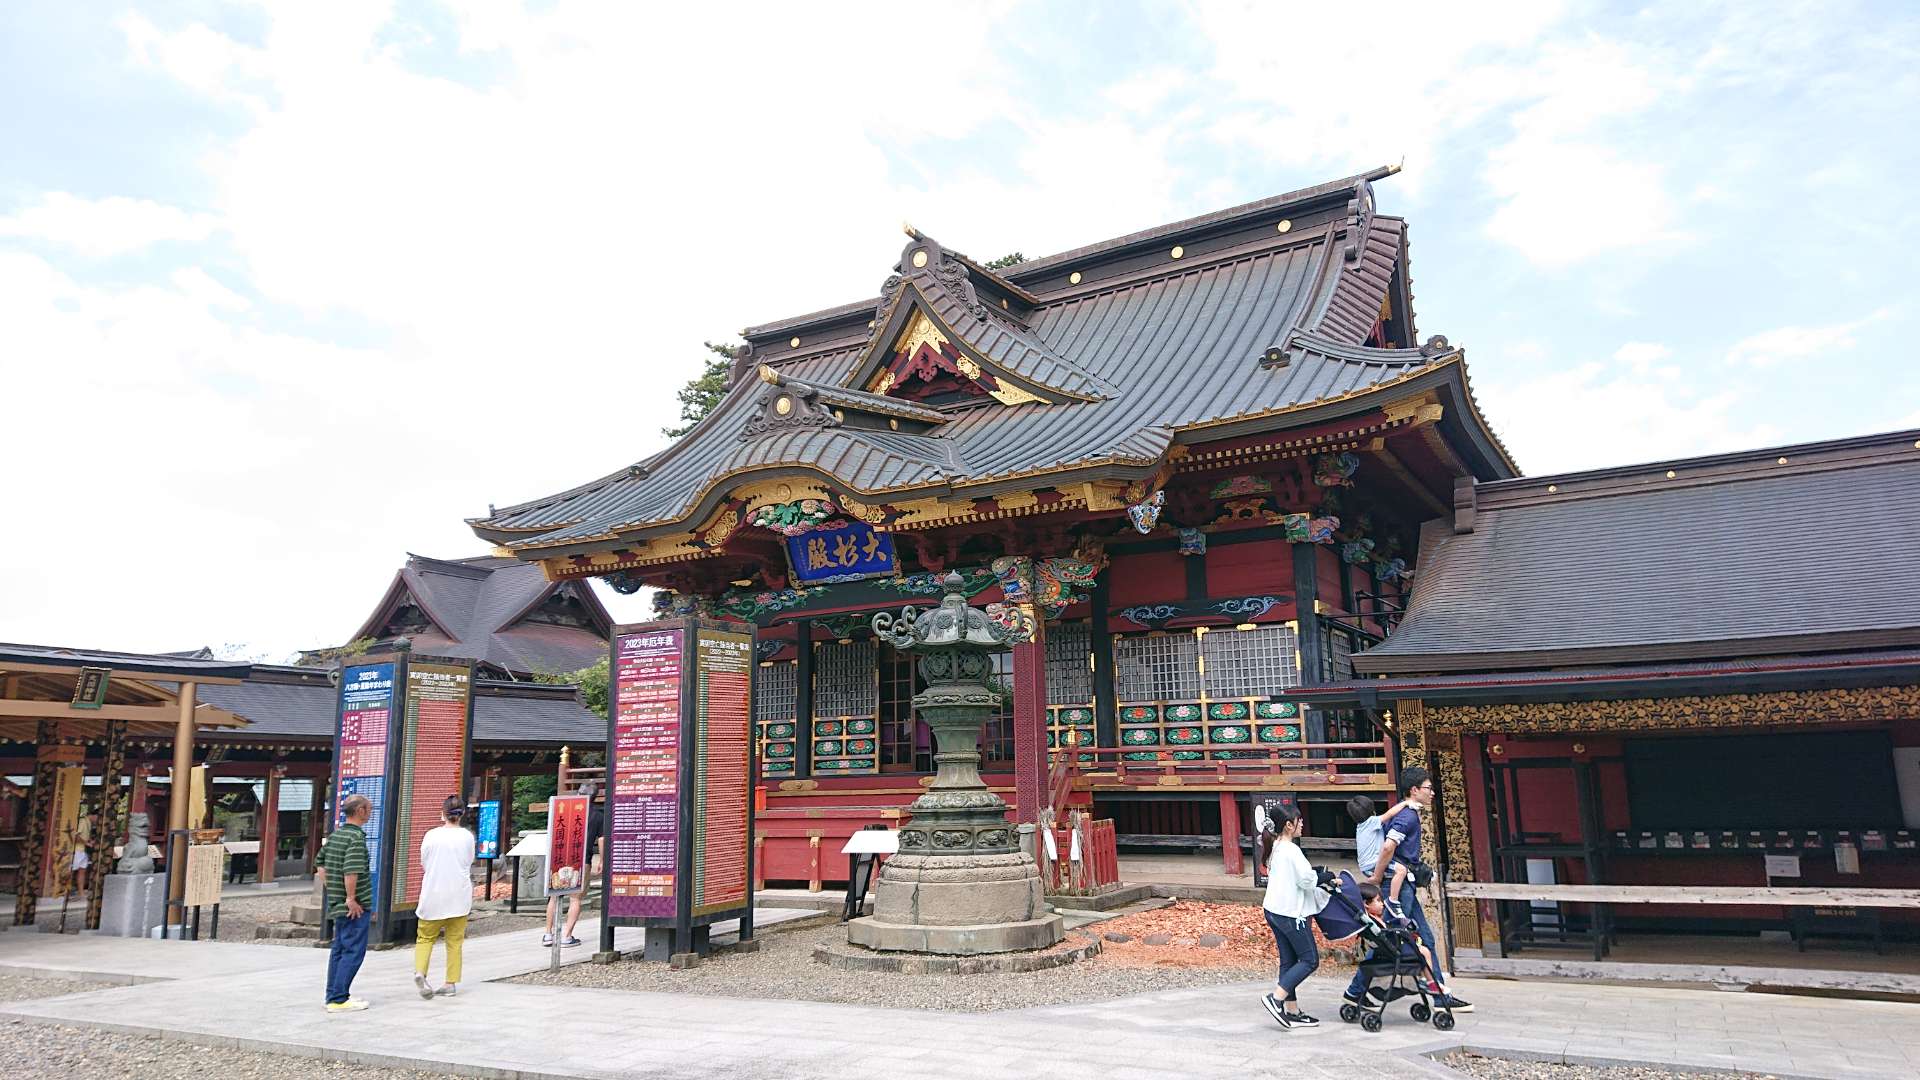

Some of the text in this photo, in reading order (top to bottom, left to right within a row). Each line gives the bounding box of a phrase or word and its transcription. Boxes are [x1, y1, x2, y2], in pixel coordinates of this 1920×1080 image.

[554, 815, 566, 865] 大国神社
[571, 814, 583, 865] 大杉神社
